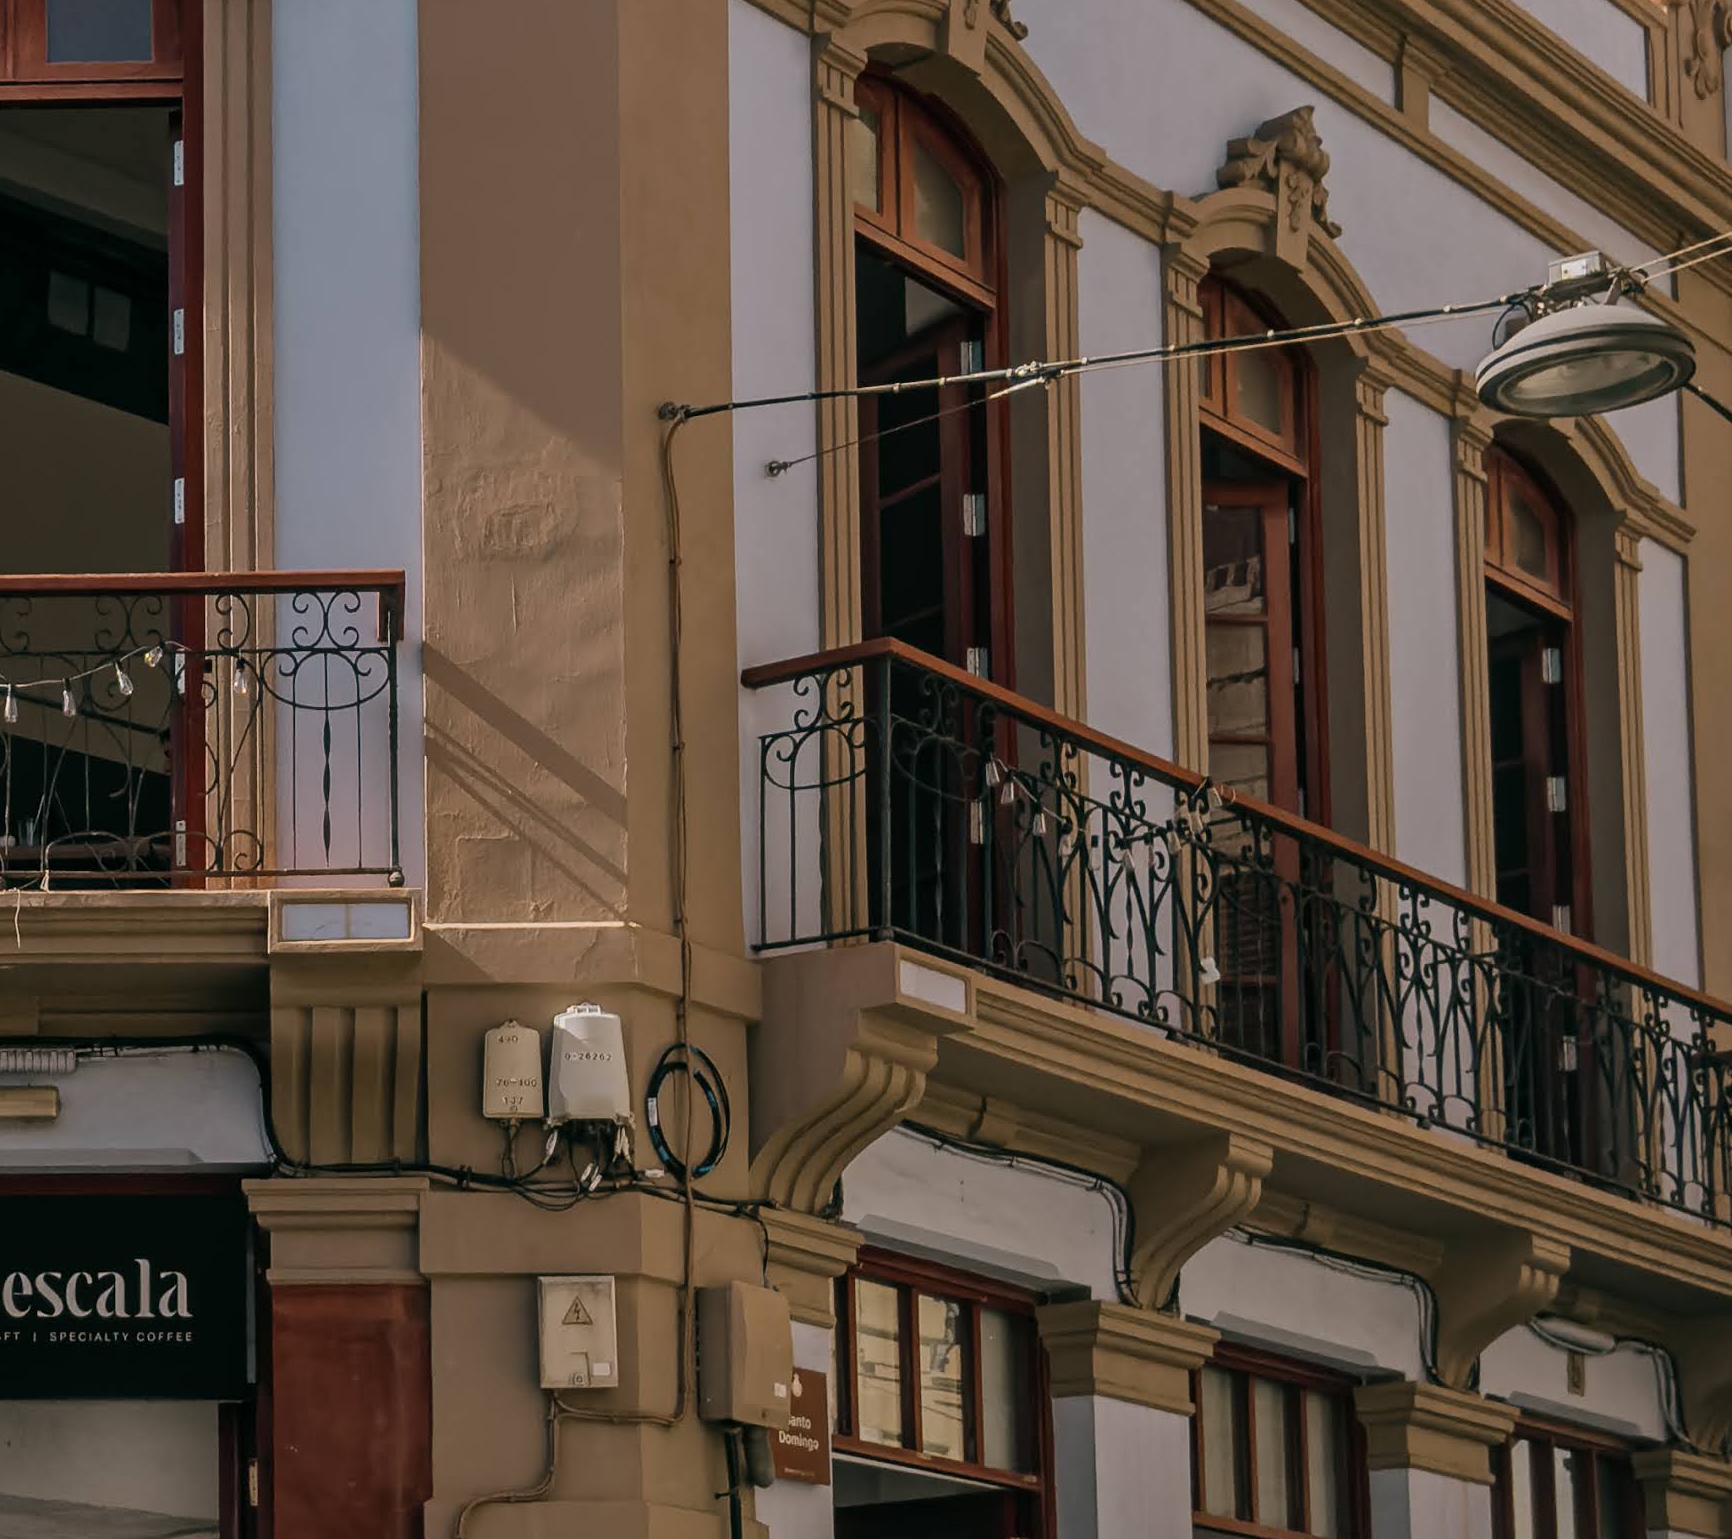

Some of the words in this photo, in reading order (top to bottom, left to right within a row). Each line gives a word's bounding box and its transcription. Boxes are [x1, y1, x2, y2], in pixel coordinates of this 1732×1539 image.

[1, 1258, 194, 1319] escala
[48, 1330, 130, 1343] SPECIALTY
[135, 1330, 193, 1343] COFFEE
[787, 1415, 812, 1430] anto
[778, 1430, 820, 1452] Domingo
